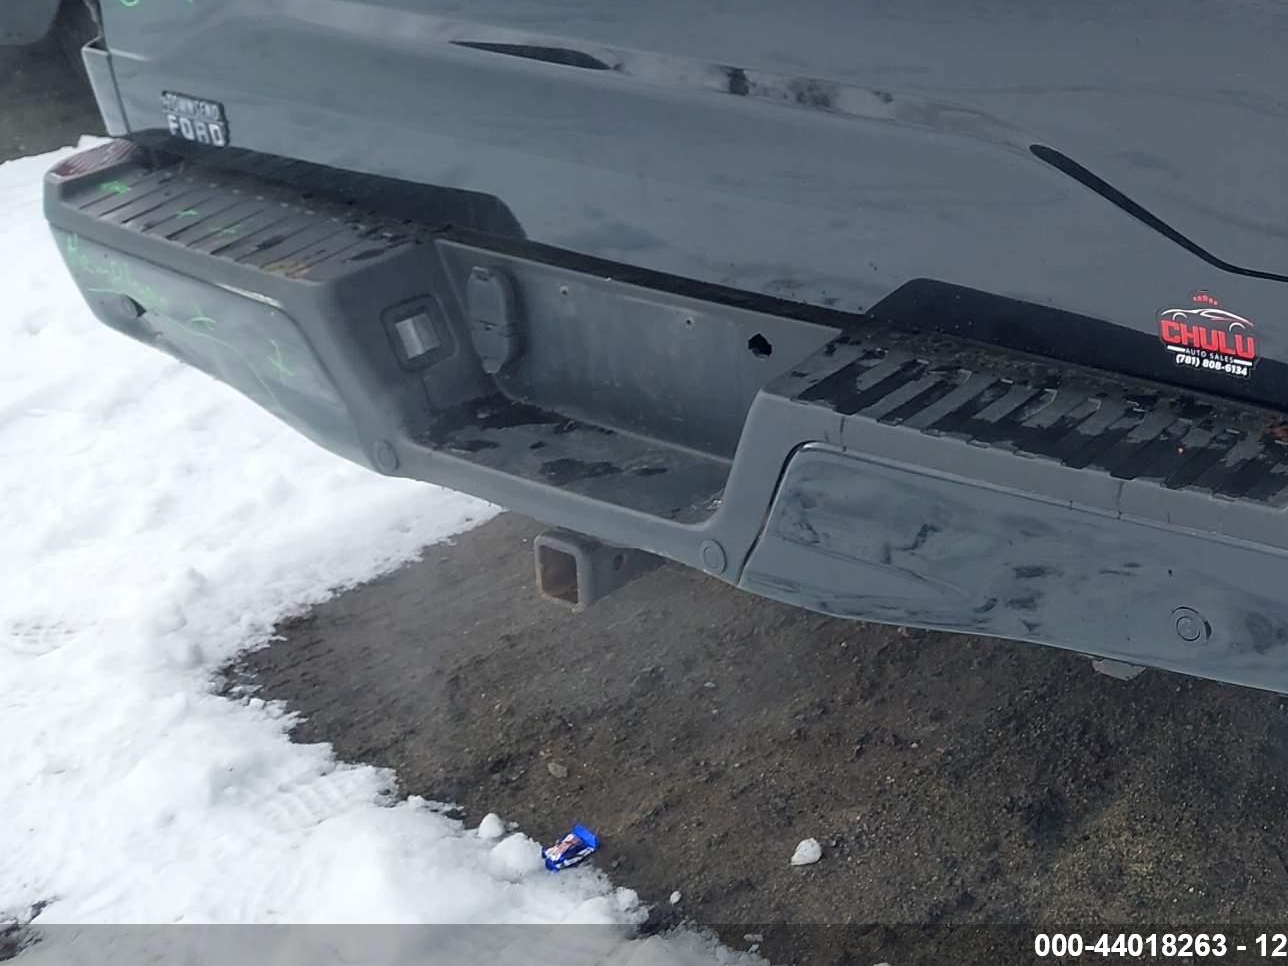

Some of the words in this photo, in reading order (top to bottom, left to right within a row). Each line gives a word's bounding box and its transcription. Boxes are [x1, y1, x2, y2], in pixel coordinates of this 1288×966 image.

[168, 114, 225, 146] FORD
[1161, 320, 1255, 359] CHULU
[1176, 354, 1200, 367] (781)
[1185, 347, 1207, 358] AUTO
[1209, 352, 1233, 363] SALES
